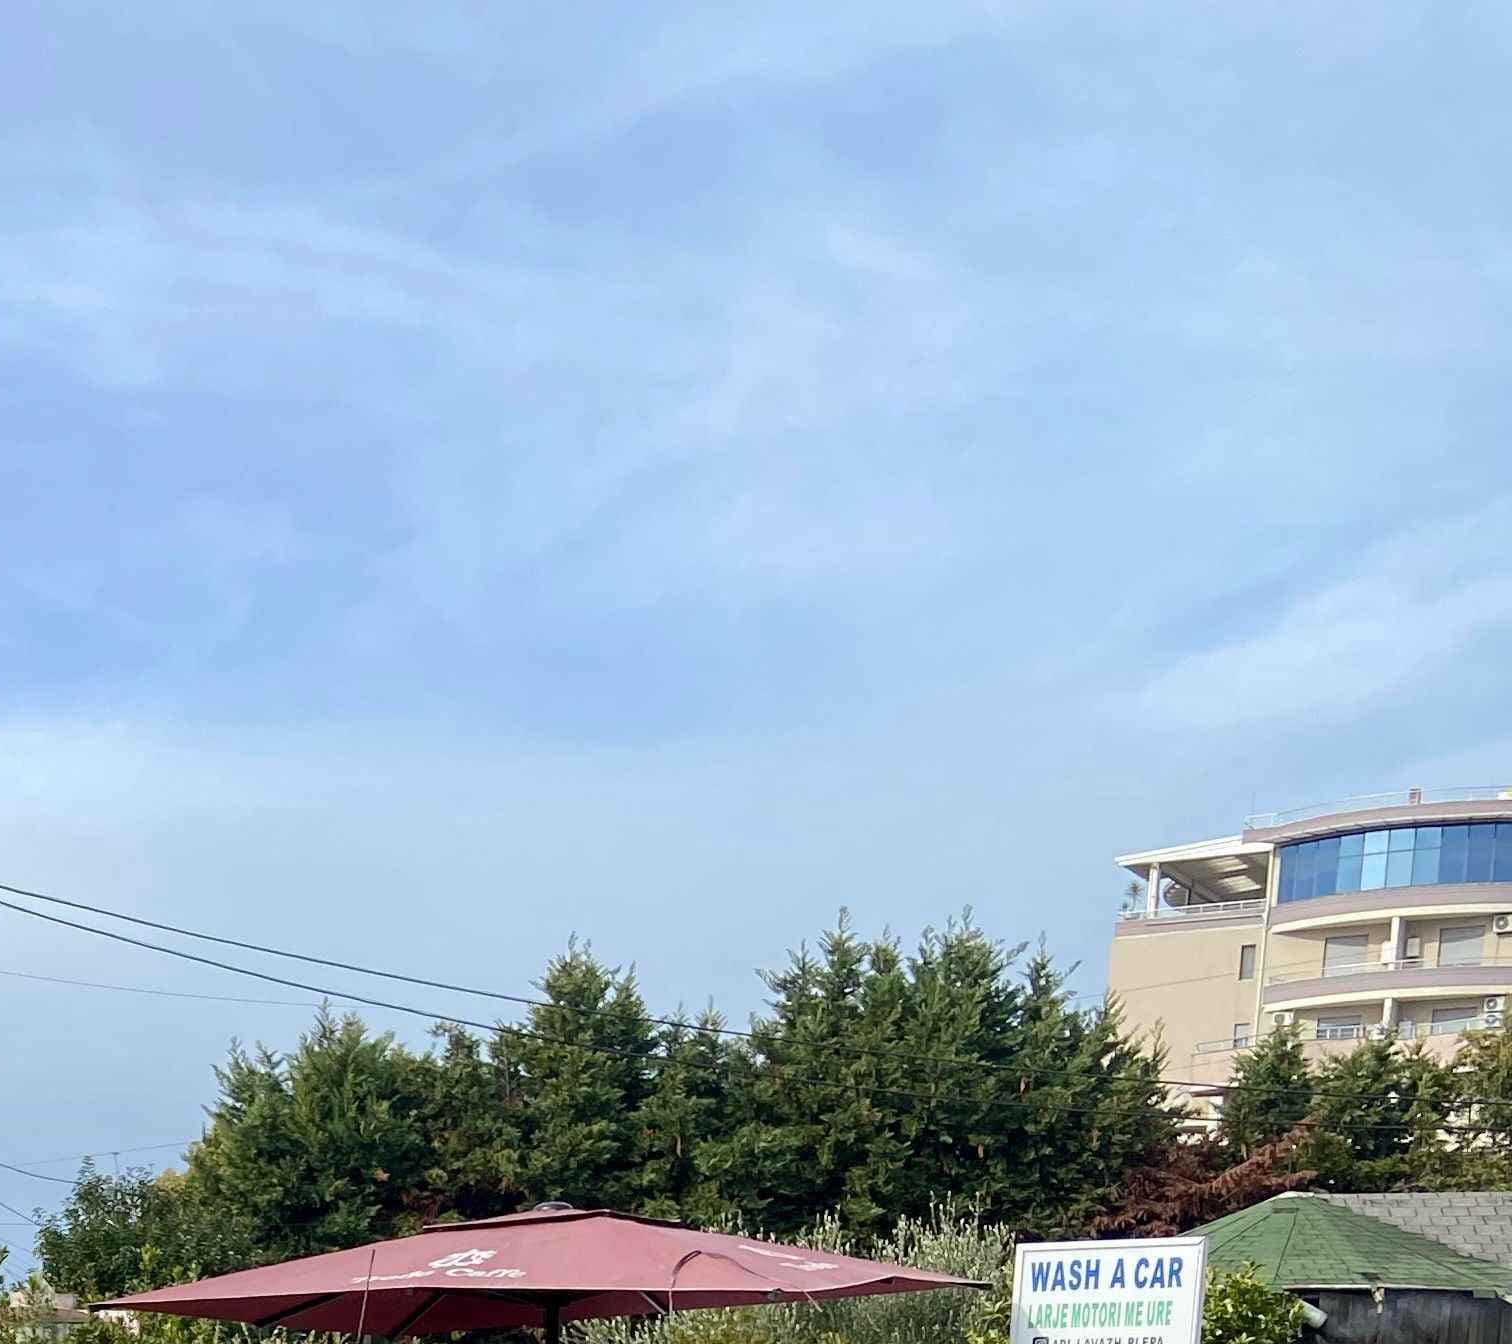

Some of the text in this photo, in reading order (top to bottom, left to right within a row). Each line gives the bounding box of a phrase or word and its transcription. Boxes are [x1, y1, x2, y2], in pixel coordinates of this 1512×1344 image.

[1031, 1256, 1183, 1293] WASH A CAR
[1028, 1300, 1173, 1329] LARJE MOTORI ME URE
